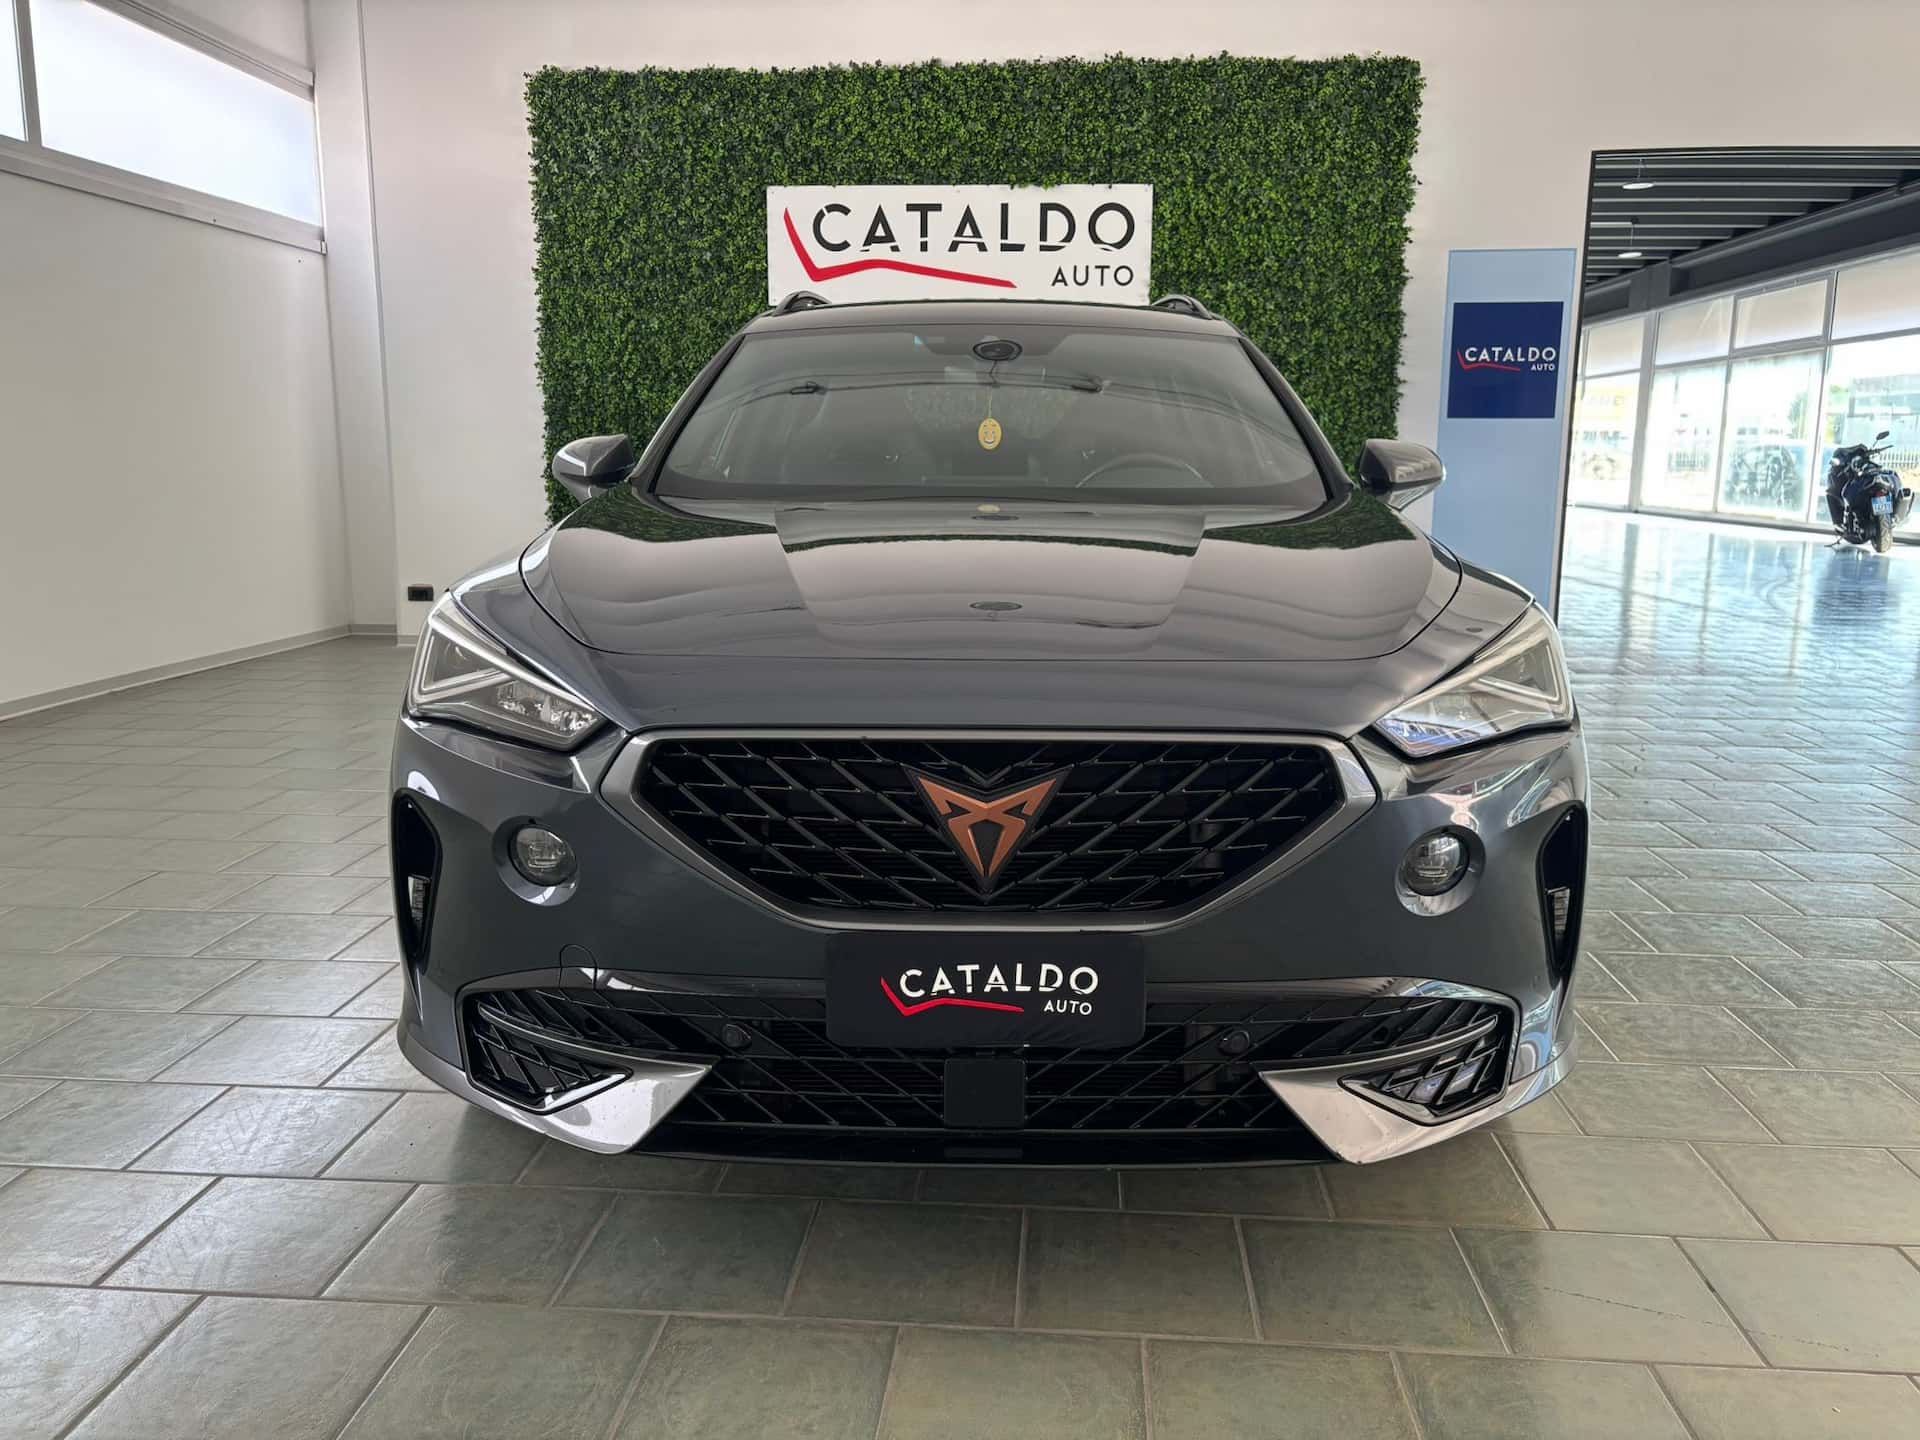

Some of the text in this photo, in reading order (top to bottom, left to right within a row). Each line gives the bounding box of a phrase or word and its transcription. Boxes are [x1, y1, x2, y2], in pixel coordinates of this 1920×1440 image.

[812, 202, 1136, 252] CATALDO
[1051, 265, 1134, 287] AUTO
[1464, 346, 1556, 362] CATALDO
[1530, 363, 1556, 371] AUTO
[899, 963, 1099, 998] CATALDO
[1043, 1000, 1093, 1016] AUTO
